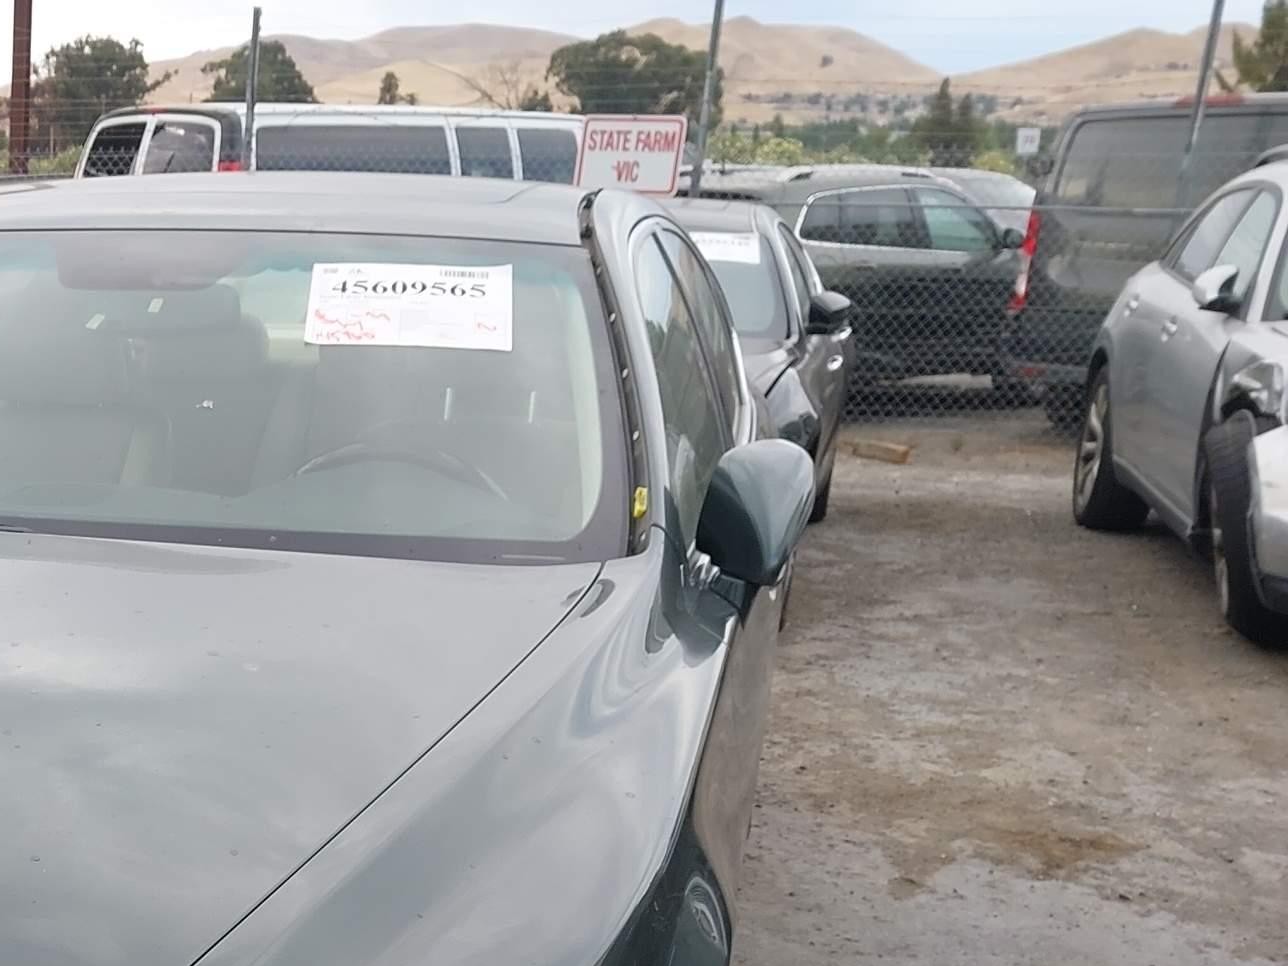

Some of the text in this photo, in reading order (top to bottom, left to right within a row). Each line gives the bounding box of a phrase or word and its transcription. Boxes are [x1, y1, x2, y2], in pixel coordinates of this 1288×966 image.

[588, 129, 676, 153] STATE FARM
[615, 160, 640, 183] VIC
[331, 279, 487, 299] 45609565
